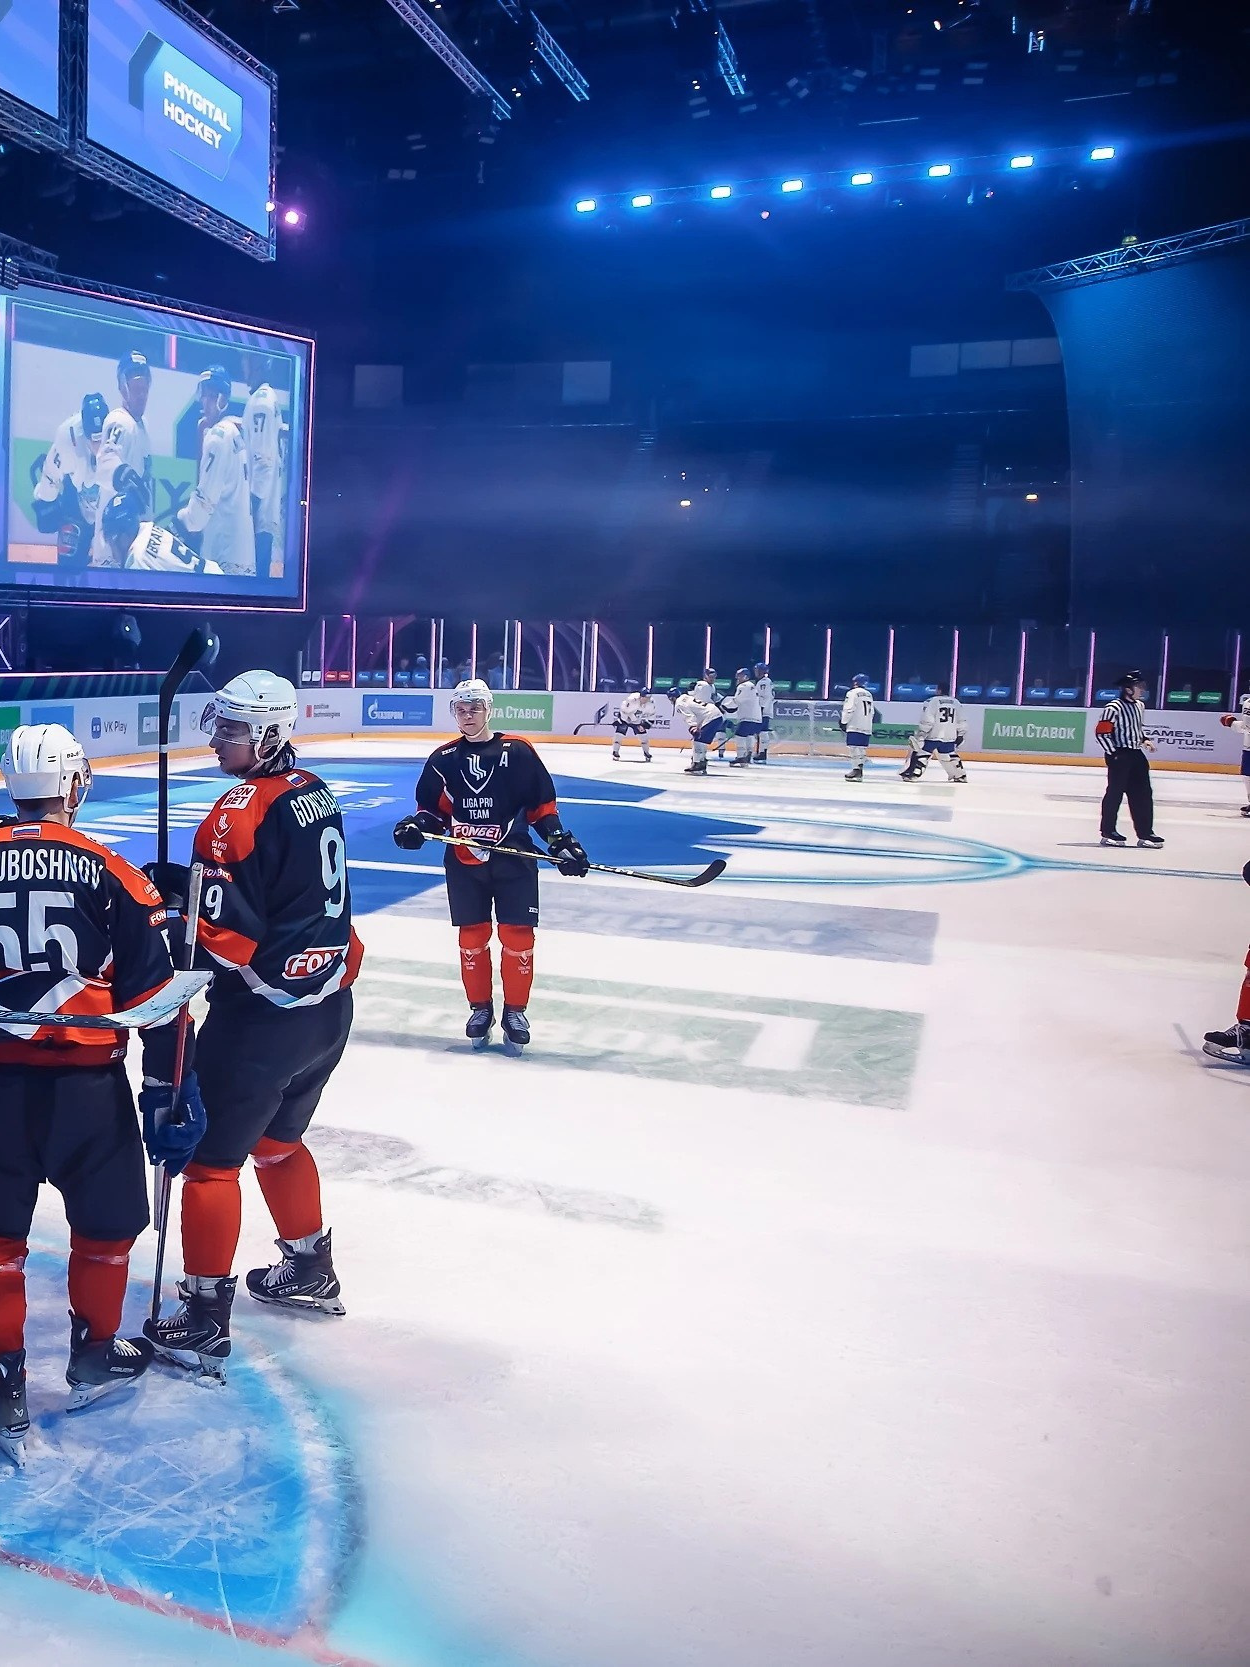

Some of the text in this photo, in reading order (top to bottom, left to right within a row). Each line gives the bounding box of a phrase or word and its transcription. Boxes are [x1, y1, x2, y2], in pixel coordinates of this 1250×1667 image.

[163, 71, 231, 132] PHYGITAL
[163, 99, 222, 149] HOCKEY
[813, 707, 842, 718] STA
[115, 720, 128, 735] Play
[1157, 737, 1215, 747] FUTURE
[499, 751, 509, 768] A
[230, 785, 252, 797] FON
[224, 795, 250, 806] BET
[462, 797, 494, 809] LIGA PRO
[468, 809, 490, 819] TEAM
[453, 824, 501, 840] FONBET
[319, 826, 346, 919] 9
[204, 884, 224, 921] 9
[278, 1284, 300, 1295] CCM
[165, 1330, 188, 1340] CCM
